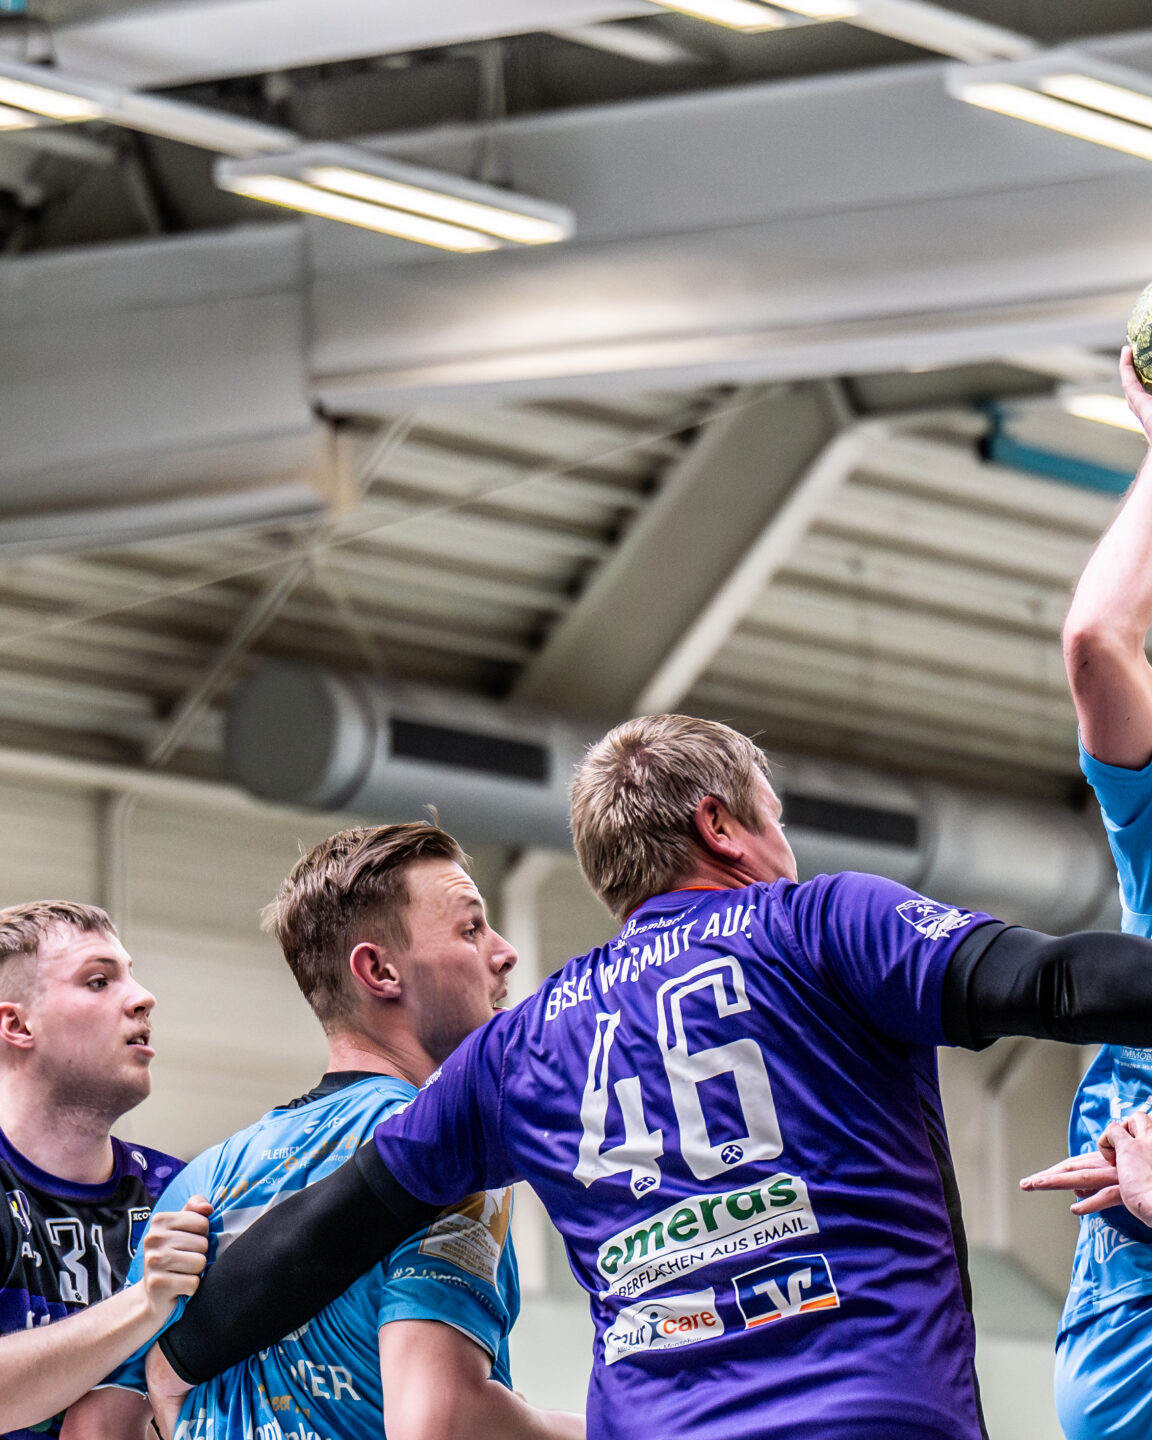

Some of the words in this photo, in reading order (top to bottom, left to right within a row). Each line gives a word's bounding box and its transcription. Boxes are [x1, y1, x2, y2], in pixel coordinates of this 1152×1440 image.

[545, 968, 592, 1022] BSG
[600, 919, 698, 995] WISMUT
[573, 955, 784, 1199] 46
[45, 1217, 113, 1306] 31
[600, 1178, 798, 1275] omeras
[614, 1253, 704, 1299] BERFLÄCHEN
[711, 1238, 749, 1258] AUS
[754, 1217, 809, 1246] EMAIL
[663, 1311, 717, 1335] care
